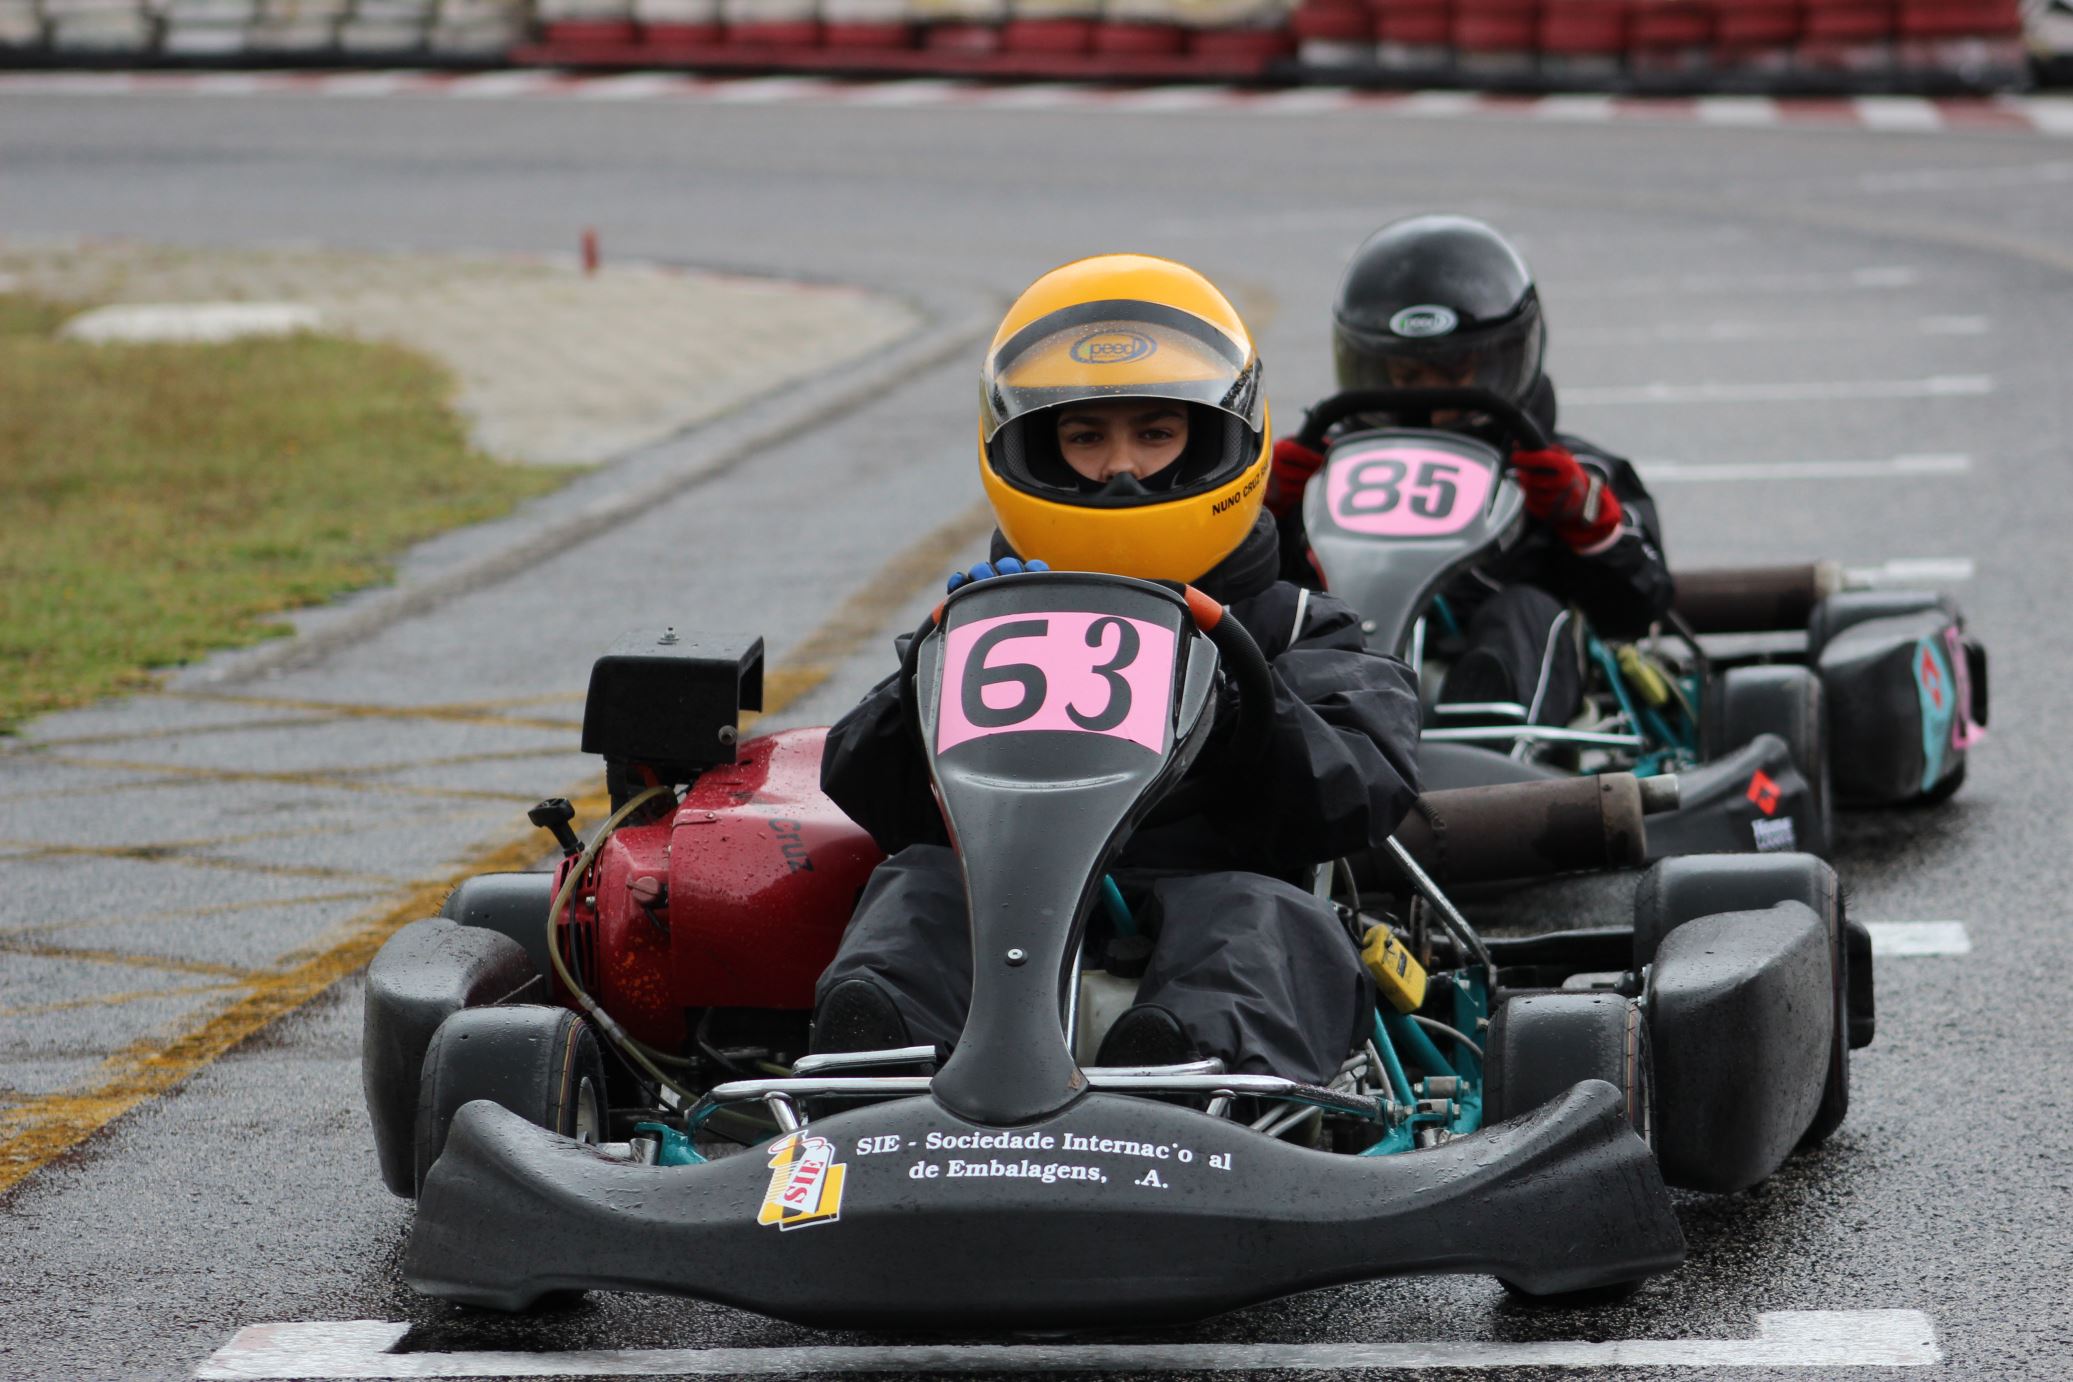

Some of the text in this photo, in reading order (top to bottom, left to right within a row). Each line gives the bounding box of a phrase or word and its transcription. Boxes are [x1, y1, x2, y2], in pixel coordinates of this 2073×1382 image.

[1212, 473, 1260, 516] NUNO CRUZ
[1338, 459, 1460, 519] 85
[961, 616, 1140, 731] 63
[856, 1134, 900, 1156] SIE
[925, 1131, 1055, 1150] Sociedade
[784, 1159, 824, 1204] SIE
[908, 1160, 940, 1179] de
[946, 1158, 1108, 1184] Embalagens,
